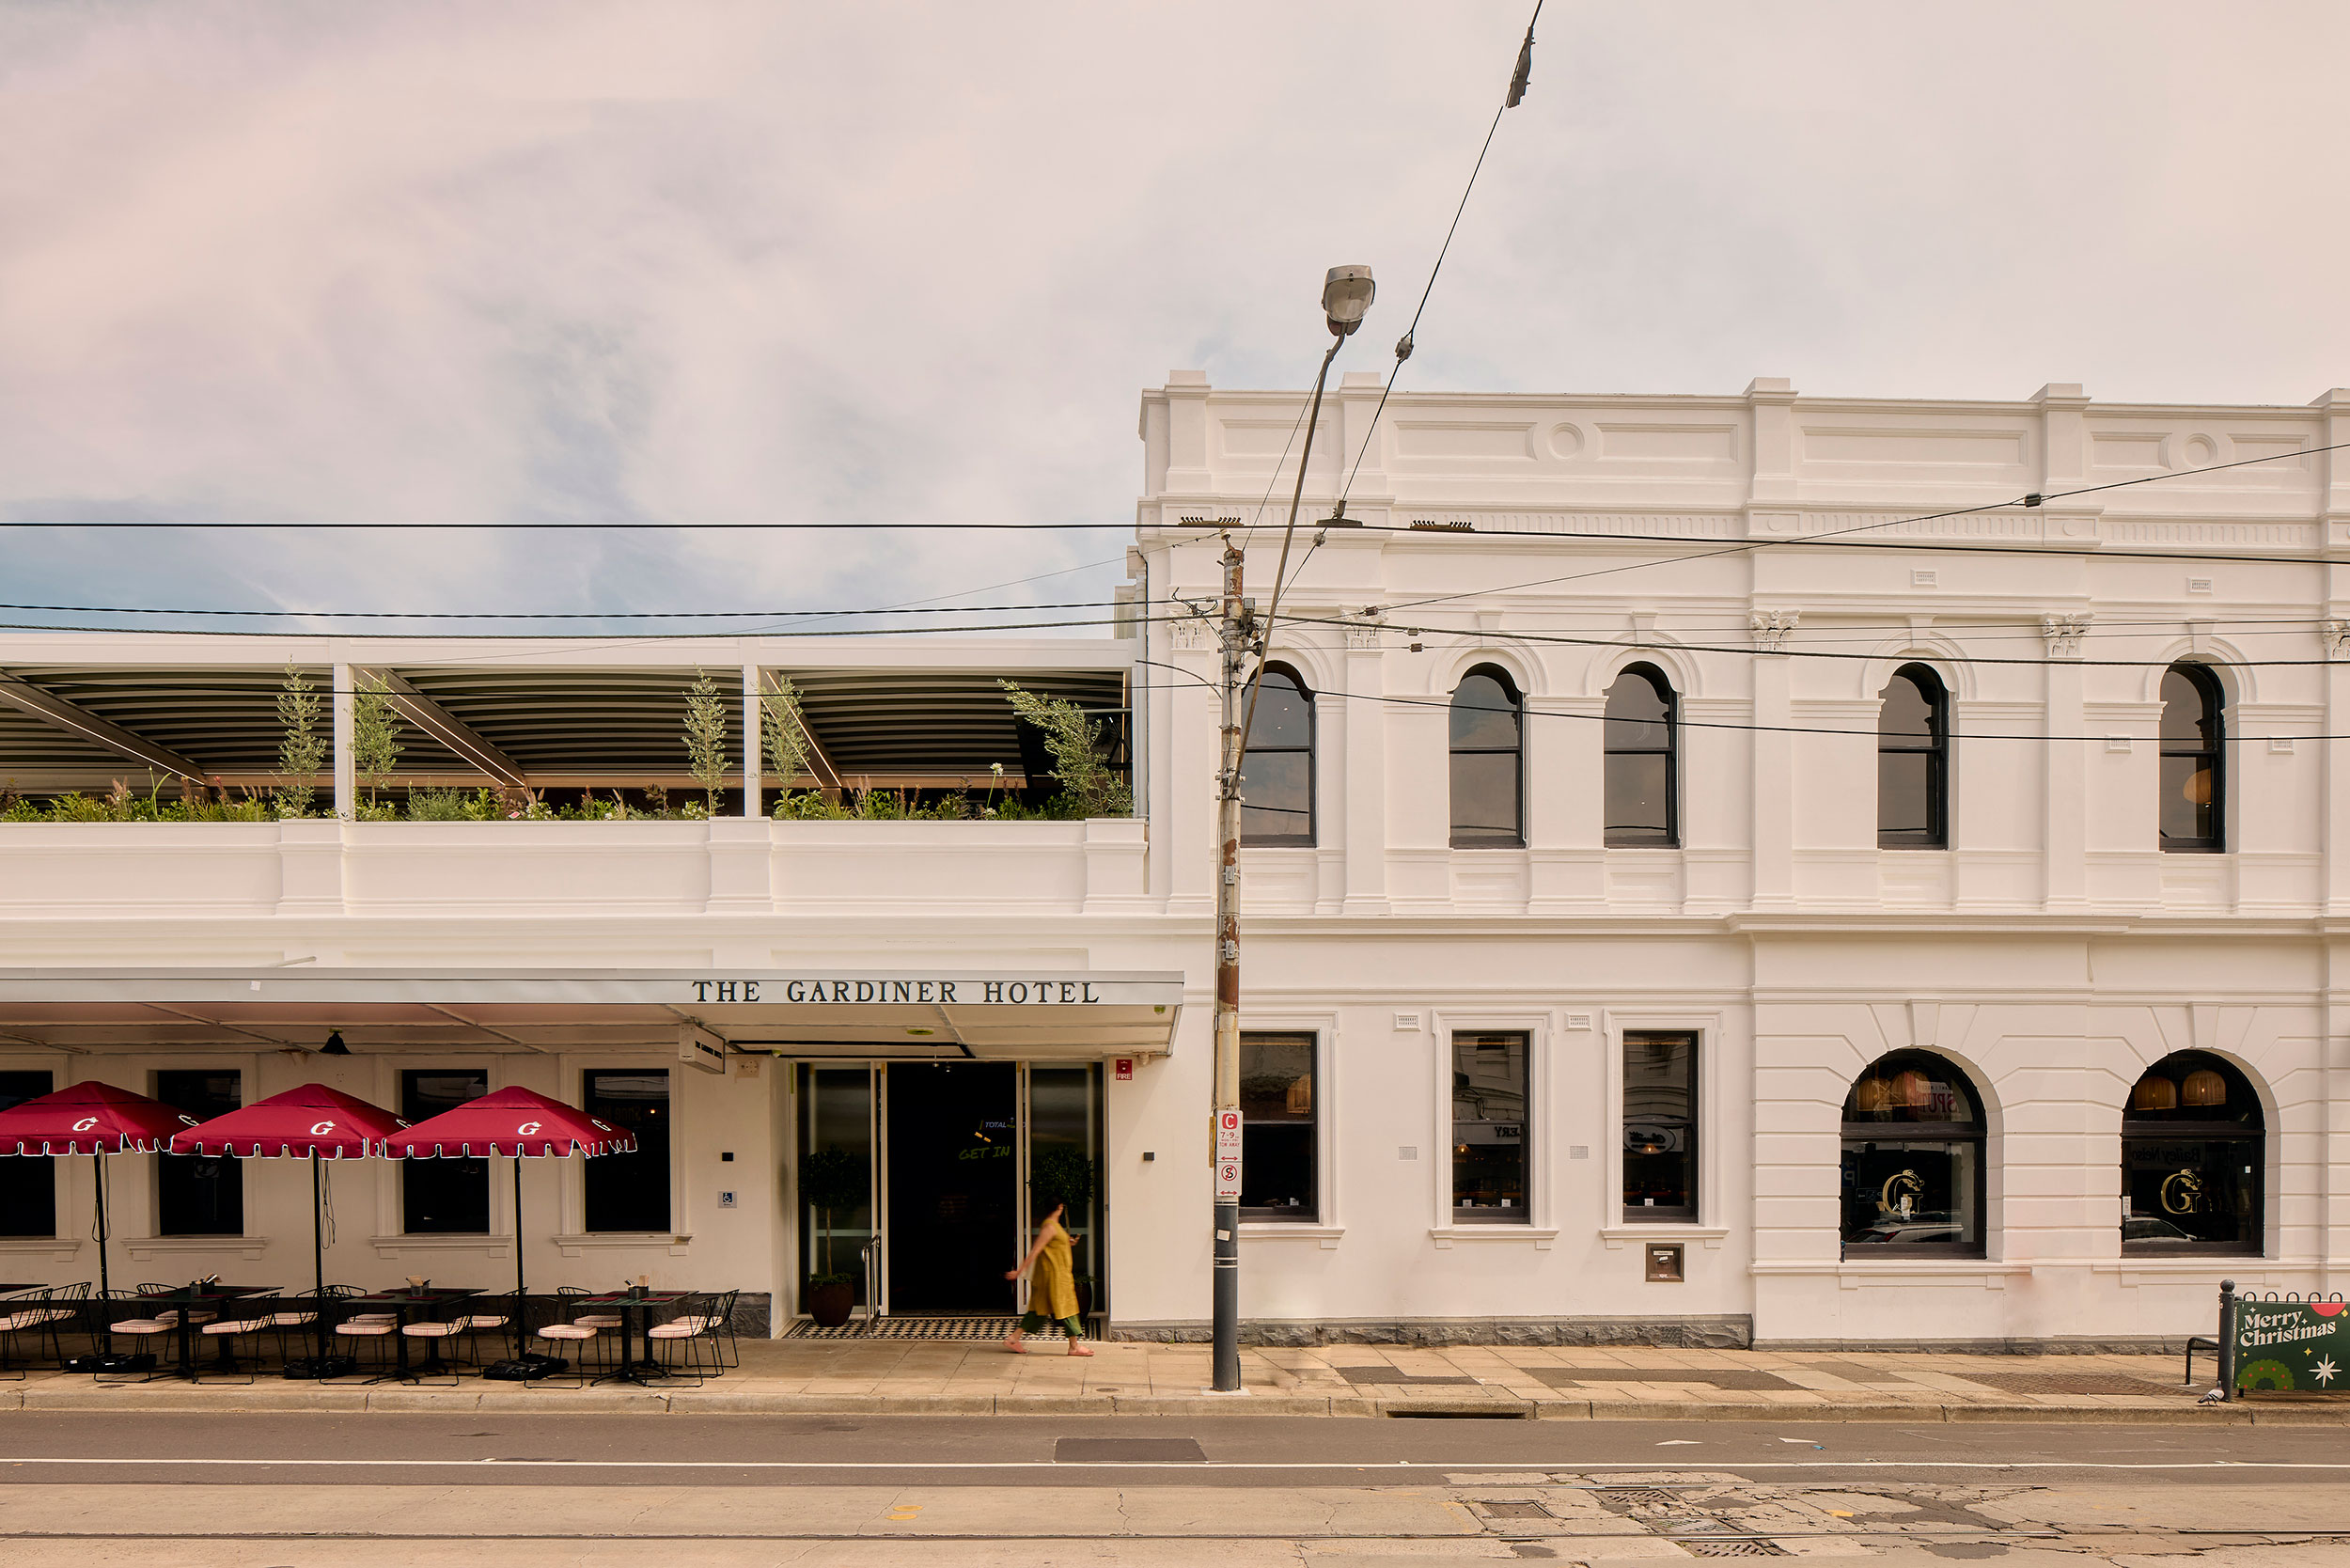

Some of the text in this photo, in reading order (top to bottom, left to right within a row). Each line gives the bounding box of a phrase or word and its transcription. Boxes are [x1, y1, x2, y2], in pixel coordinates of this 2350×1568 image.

[692, 980, 1100, 1004] THE GARDINER HOTEL
[1225, 1115, 1234, 1128] C
[959, 1146, 1010, 1160] GET IN
[2160, 1168, 2202, 1215] G
[2244, 1310, 2303, 1330] Merry
[2240, 1321, 2337, 1347] Christmas
